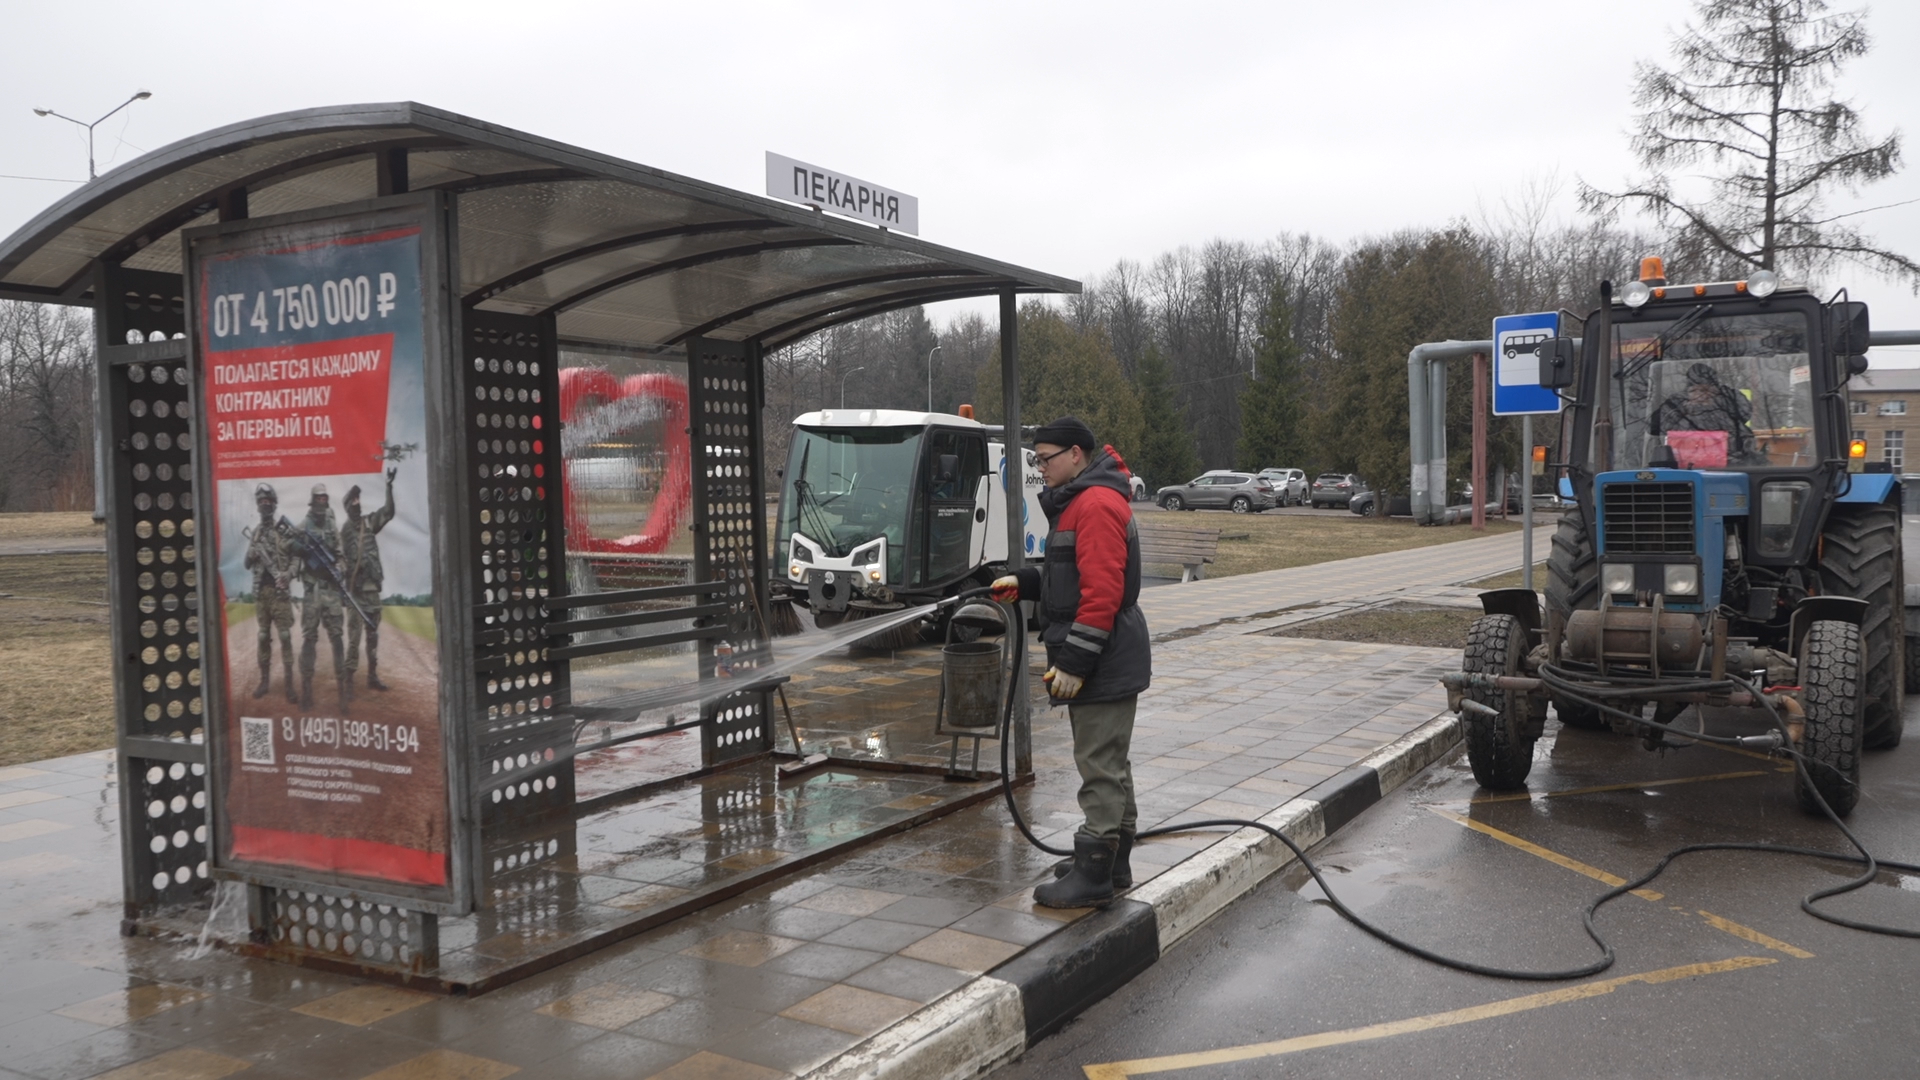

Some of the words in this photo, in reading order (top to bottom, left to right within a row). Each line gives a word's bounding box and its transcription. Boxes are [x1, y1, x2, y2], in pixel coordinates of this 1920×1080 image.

[794, 166, 899, 224] ПЕКАРНЯ
[214, 293, 244, 337] ОТ
[250, 291, 268, 333] 4
[272, 284, 319, 331] 750
[322, 276, 370, 326] 000
[214, 358, 309, 385] ПОЛАГАЕТСЯ
[312, 350, 381, 378] КАЖДОМУ
[215, 386, 331, 413] КОНТРАКТНИКУ
[217, 421, 235, 441] ЗА
[237, 413, 300, 440] ПЕРВЫЙ
[304, 415, 333, 439] ГОД
[1025, 473, 1046, 485] Johns
[282, 717, 295, 741] 8
[300, 717, 340, 749] (495)
[343, 720, 419, 752] 598-51-94
